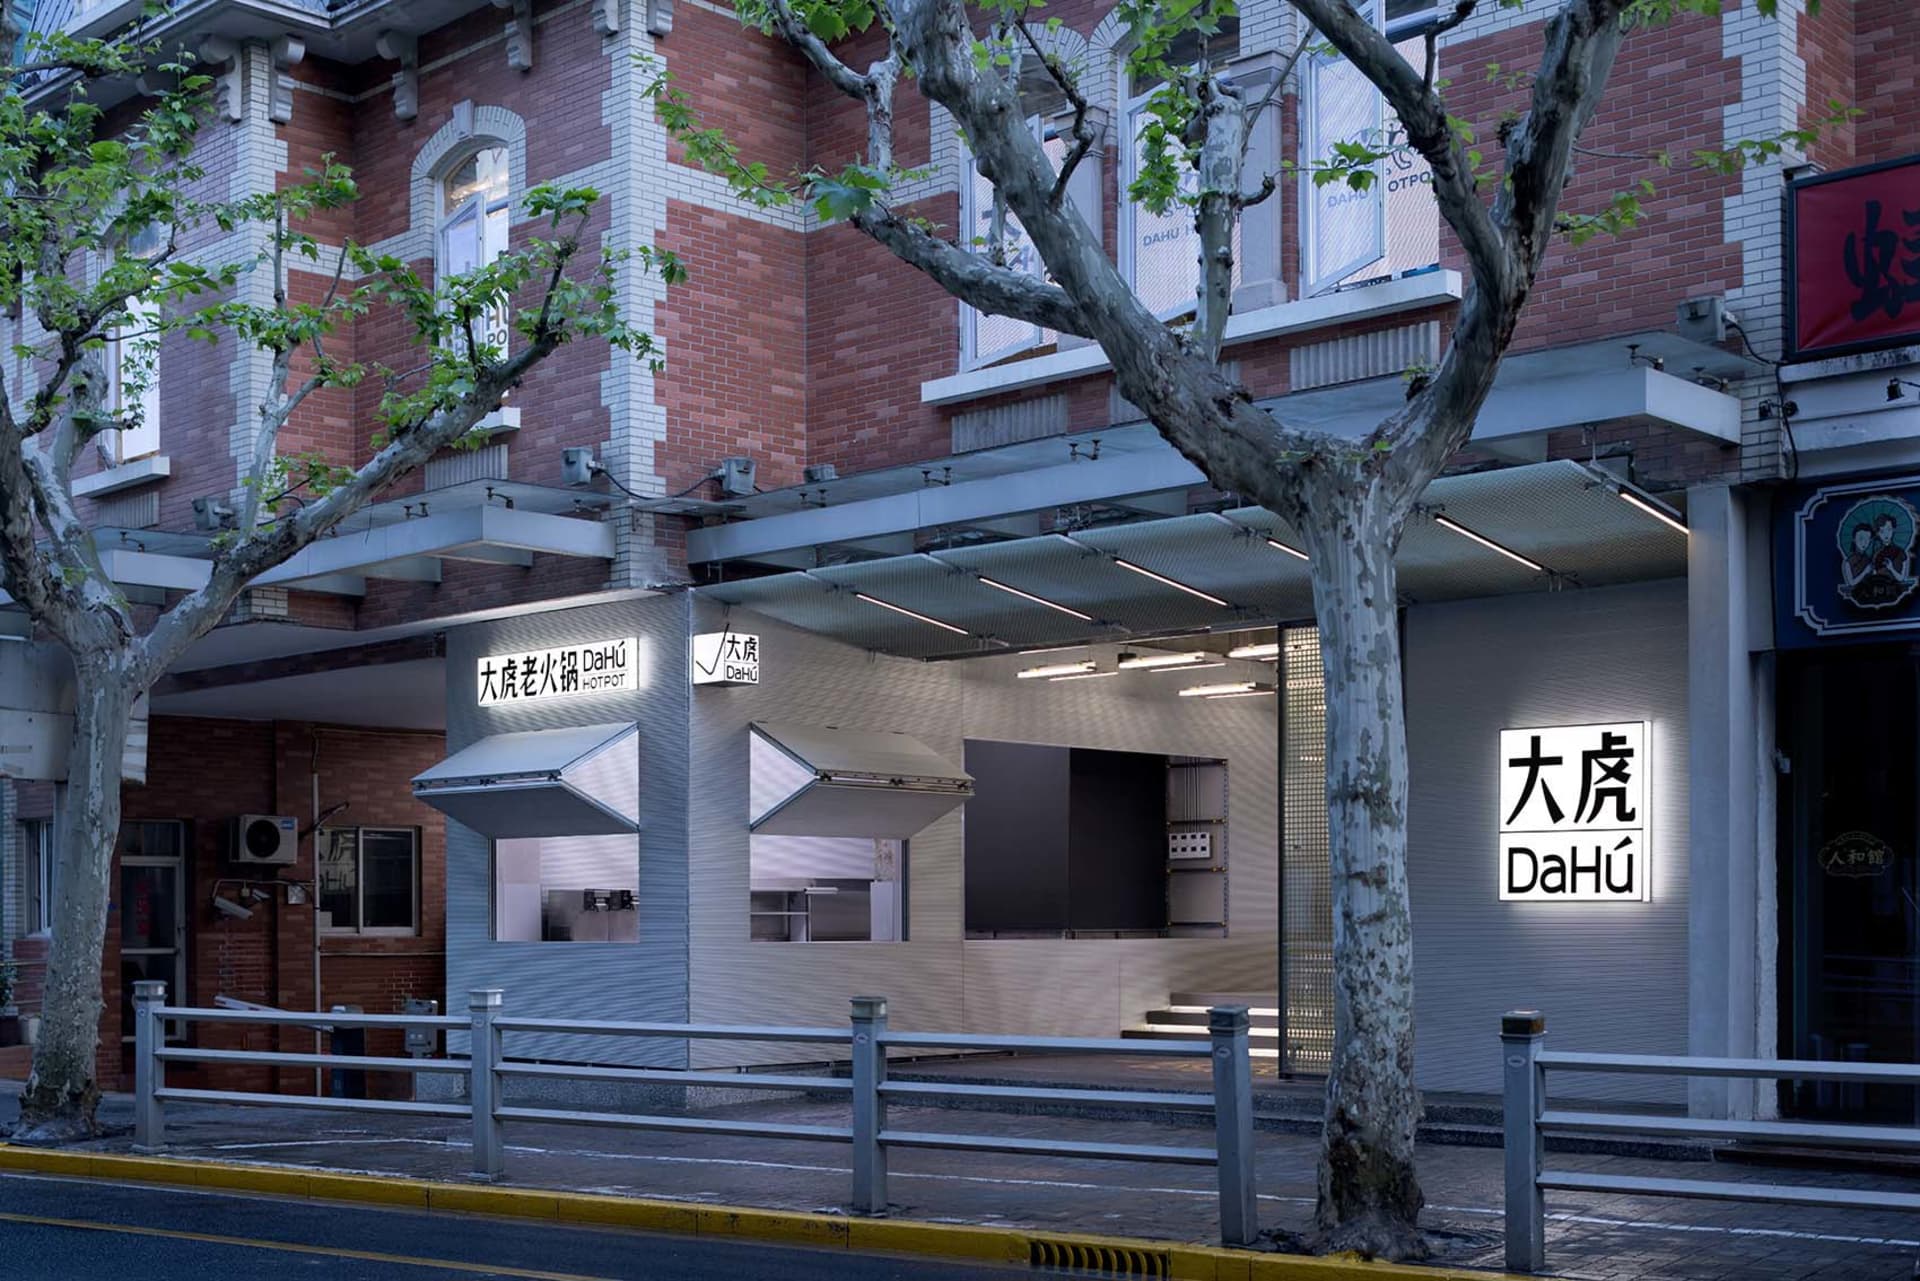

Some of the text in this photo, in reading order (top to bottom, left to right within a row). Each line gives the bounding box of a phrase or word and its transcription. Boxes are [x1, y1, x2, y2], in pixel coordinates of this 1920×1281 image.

[1388, 170, 1432, 192] OTPO
[1143, 228, 1179, 246] DAHU
[583, 640, 625, 672] DaHú
[727, 635, 758, 662] 大虎
[480, 650, 578, 702] 大虎老火锅
[582, 673, 625, 690] HOTPOT
[726, 664, 758, 681] DaHú
[1505, 731, 1636, 825] 大虎
[1507, 835, 1633, 894] DaHú
